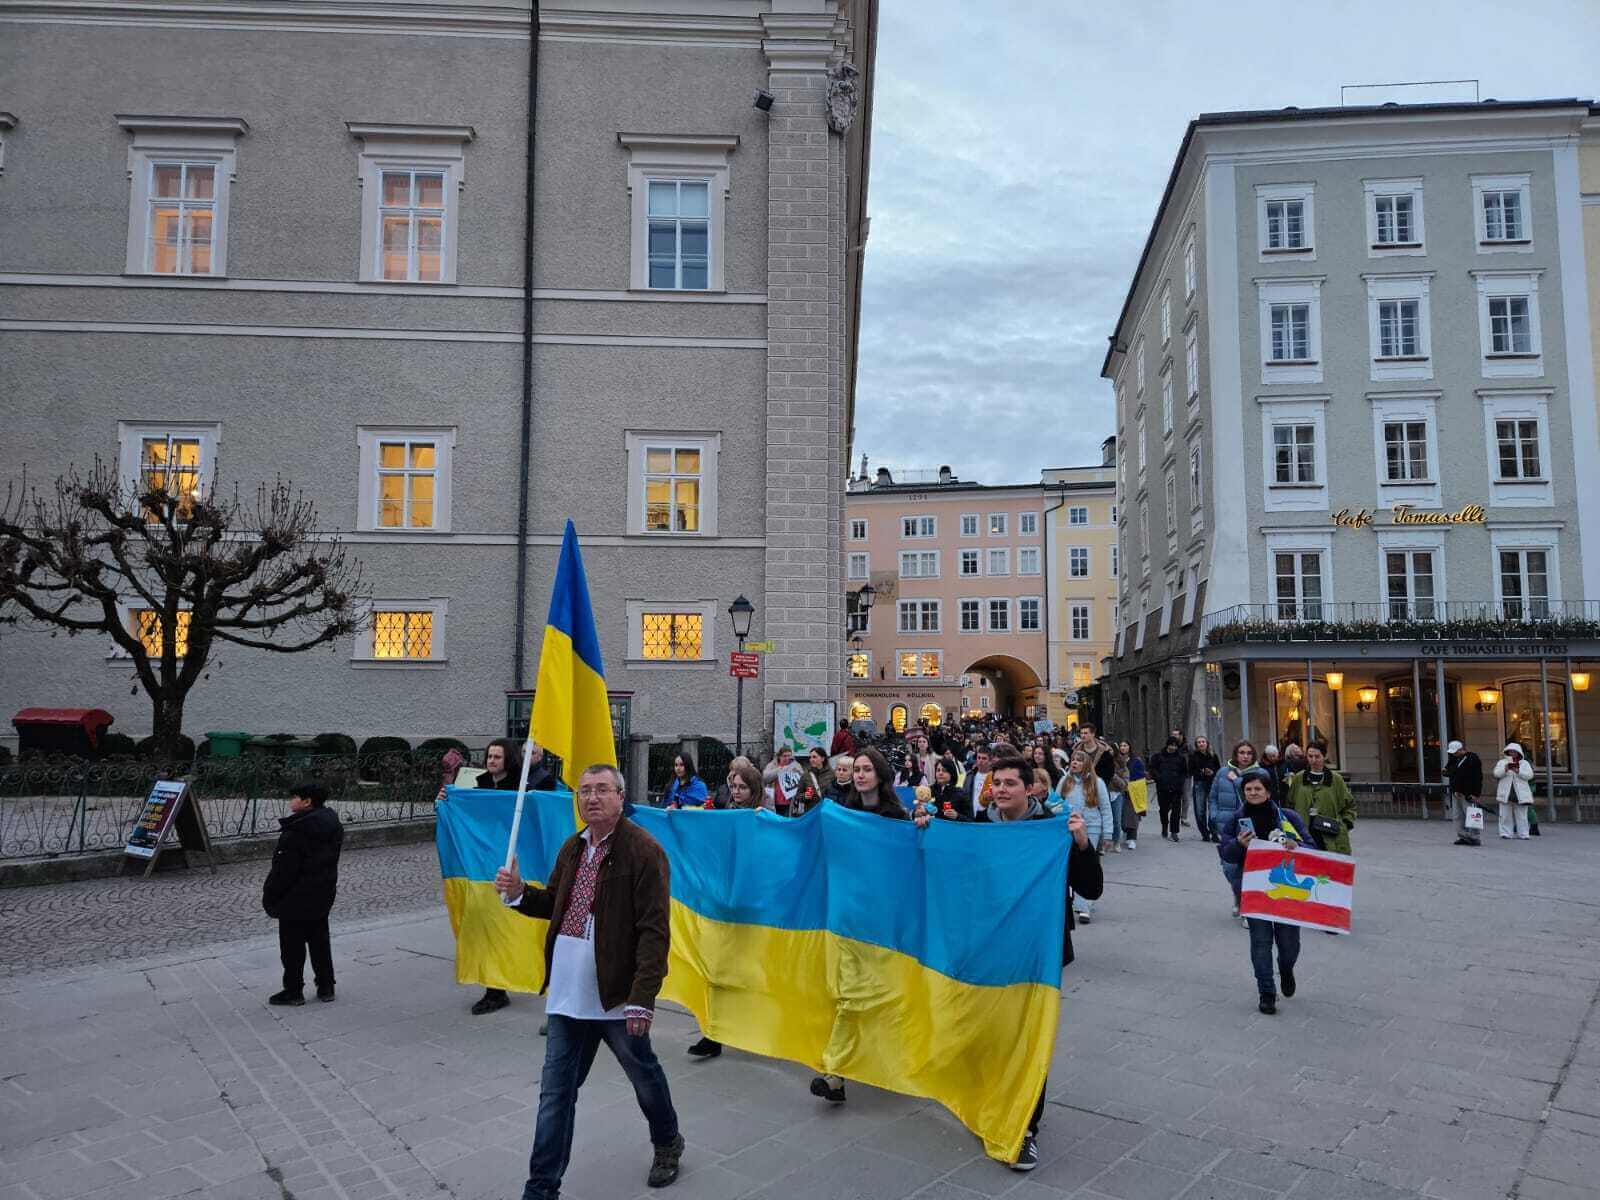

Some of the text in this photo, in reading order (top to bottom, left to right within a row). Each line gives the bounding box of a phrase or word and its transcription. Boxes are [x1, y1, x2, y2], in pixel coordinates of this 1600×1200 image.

[1393, 503, 1487, 524] Tomaselli
[1453, 645, 1514, 655] TOMASELLI
[1518, 645, 1541, 655] SEIT
